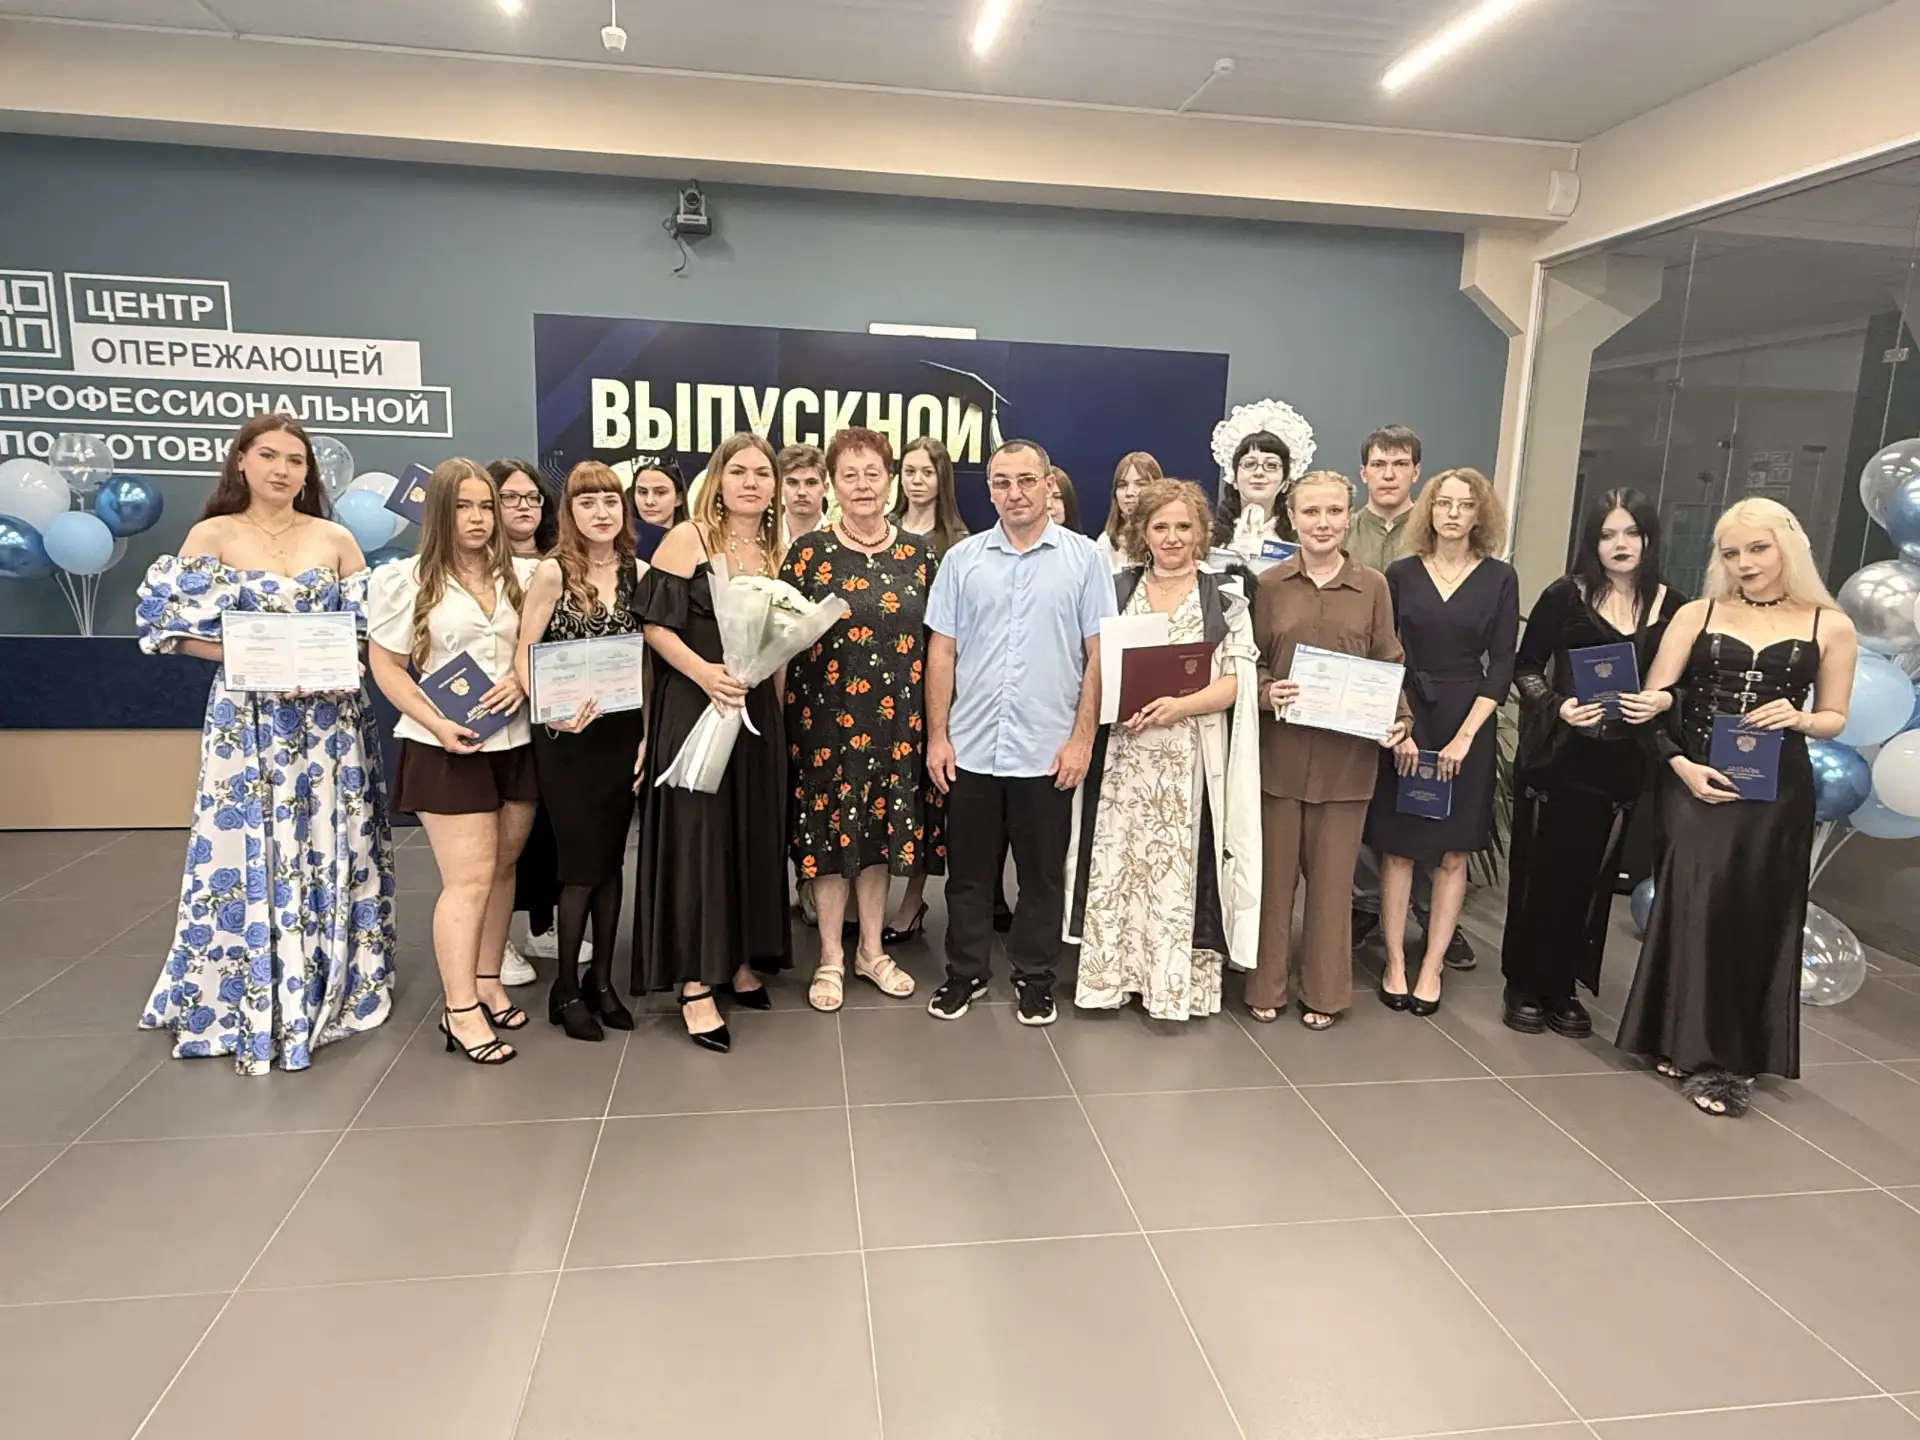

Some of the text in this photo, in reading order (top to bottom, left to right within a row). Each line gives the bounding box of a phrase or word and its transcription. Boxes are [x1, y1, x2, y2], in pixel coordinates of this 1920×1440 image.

[86, 290, 214, 322] ЦЕНТР
[92, 338, 383, 378] ОПЕРЕЖАЮЩЕЙ
[0, 384, 430, 425] ПРОФЕССИОНАЛЬНОЙ
